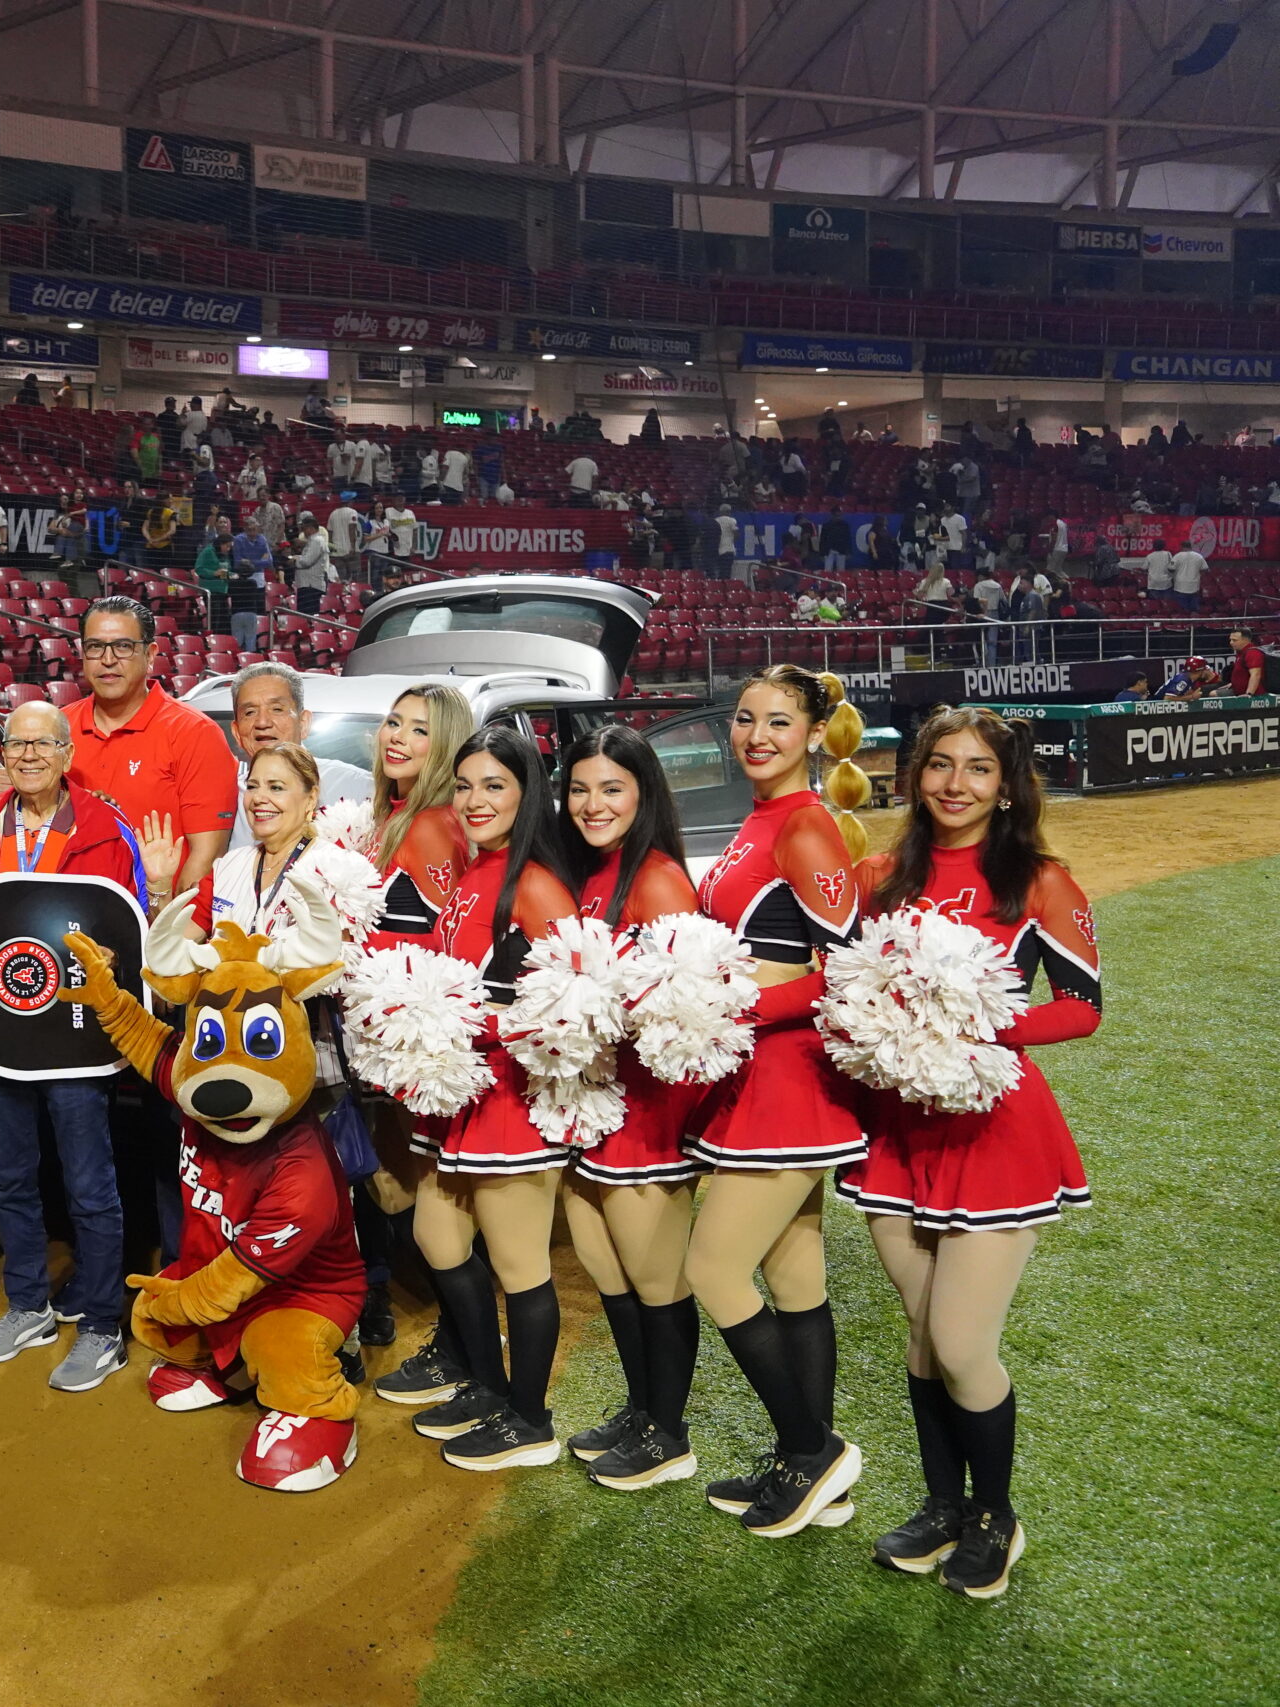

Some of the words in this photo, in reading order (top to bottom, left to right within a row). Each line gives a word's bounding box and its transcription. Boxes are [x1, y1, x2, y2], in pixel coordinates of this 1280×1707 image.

[1077, 229, 1139, 250] HERSA
[1166, 235, 1224, 253] Chevron
[31, 282, 100, 310] telcel
[108, 289, 174, 317] telcel
[181, 297, 243, 323] telcel
[386, 316, 429, 339] 97.9
[154, 349, 171, 361] DEL
[757, 347, 806, 361] GIPROSSA
[807, 349, 855, 362] GIPROSSA
[857, 351, 904, 365] GIPROSSA
[1130, 356, 1273, 377] CHANGAN
[603, 372, 679, 391] Sindicato
[682, 375, 719, 393] Frito
[447, 526, 585, 553] AUTOPARTES
[1115, 538, 1155, 552] LOBOS
[963, 664, 1071, 698] POWERADE
[1002, 707, 1035, 718] ARCO
[1134, 701, 1189, 715] POWERADE
[1127, 718, 1280, 766] POWERADE
